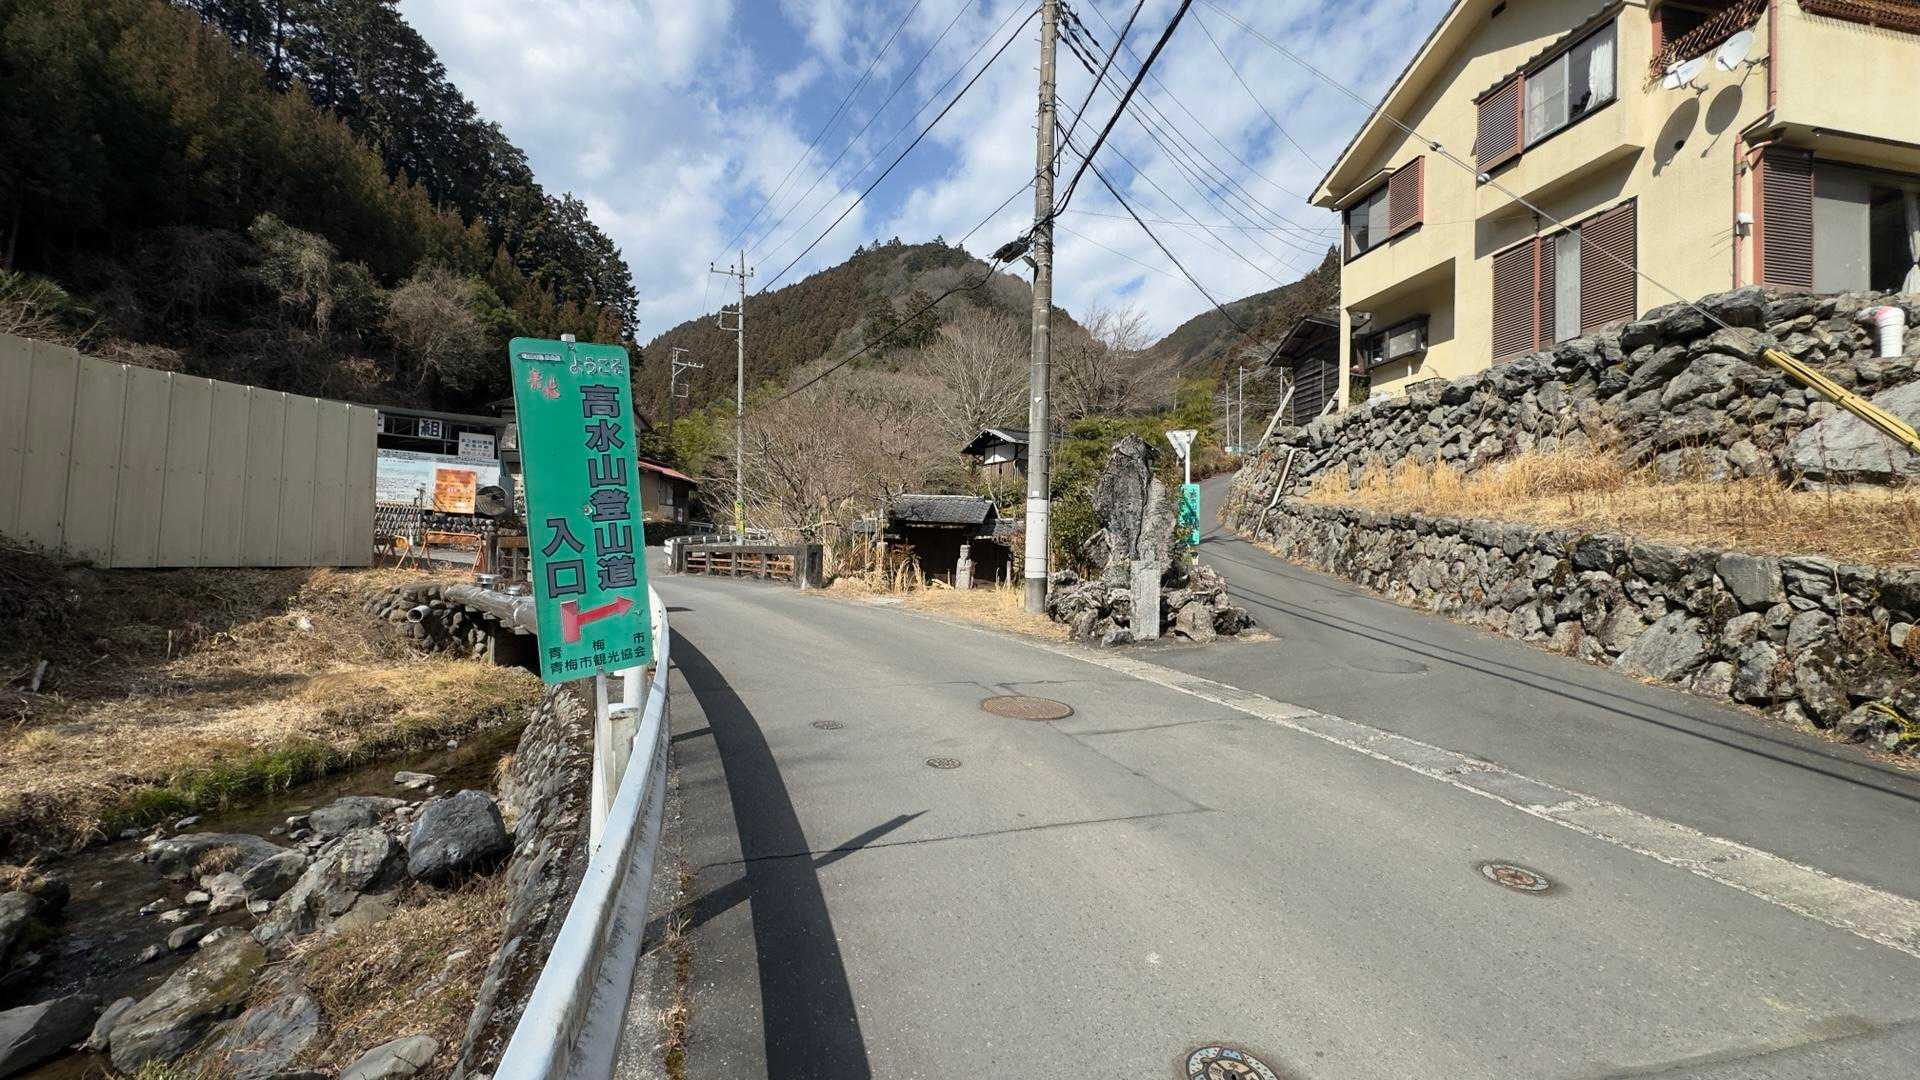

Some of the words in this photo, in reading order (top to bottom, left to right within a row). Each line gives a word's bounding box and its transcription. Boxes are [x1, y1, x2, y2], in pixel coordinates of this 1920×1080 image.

[569, 352, 625, 377] ようこそ
[580, 384, 637, 591] 高水山登山道
[543, 517, 586, 599] 入口
[551, 646, 646, 675] 青梅市観光協会
